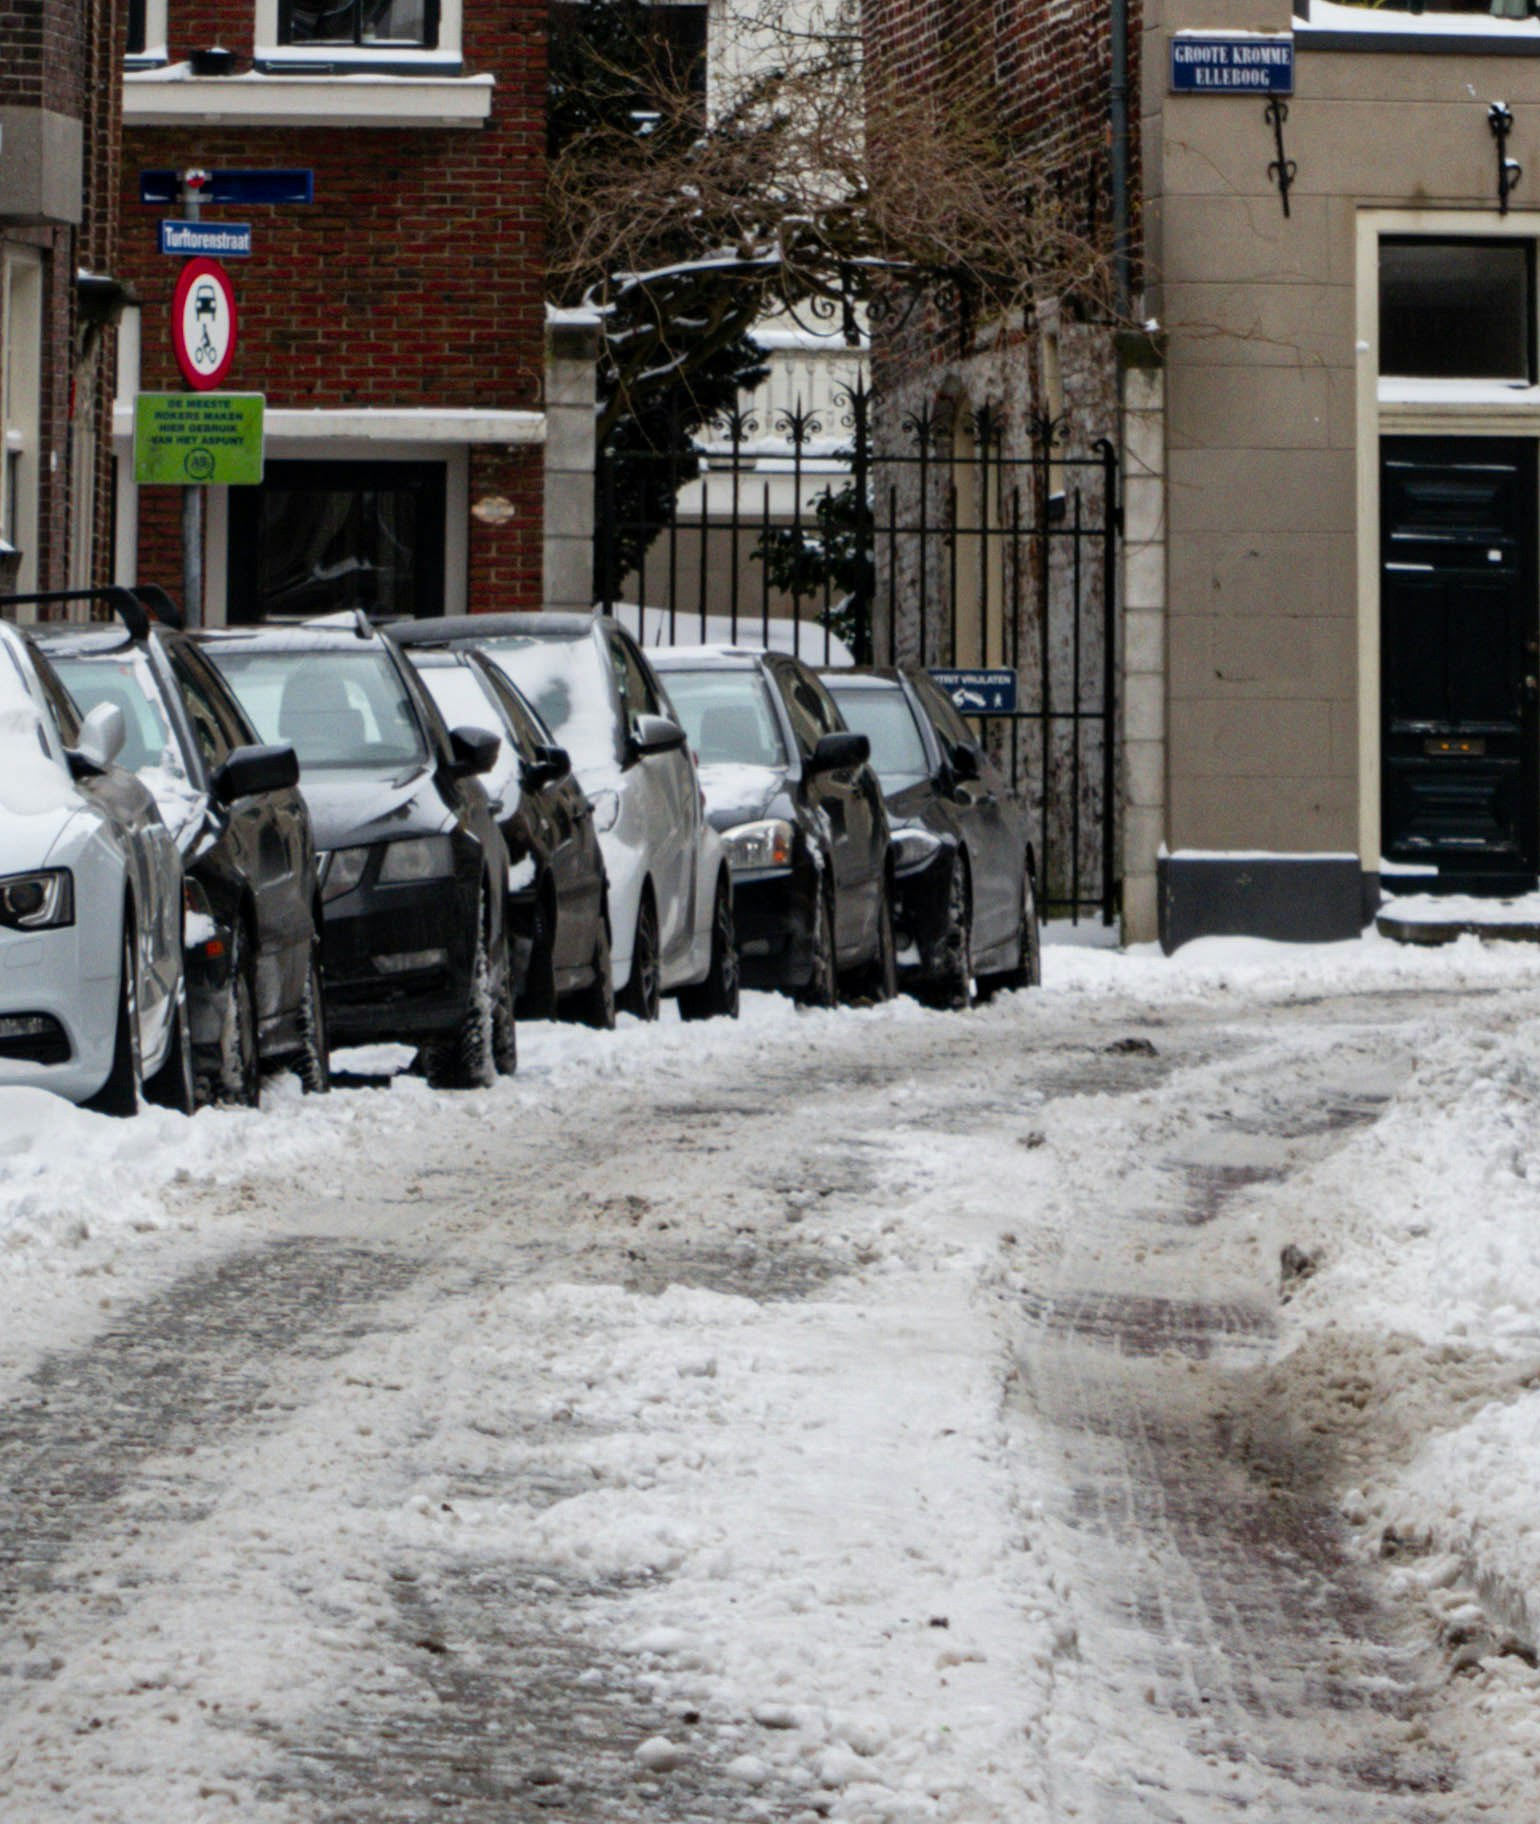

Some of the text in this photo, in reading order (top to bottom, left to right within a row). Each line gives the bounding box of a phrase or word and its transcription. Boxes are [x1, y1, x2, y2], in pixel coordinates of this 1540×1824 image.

[1175, 46, 1290, 65] GROOTE KROMME
[1195, 67, 1270, 86] ELLEBOOG
[165, 226, 249, 250] Turftorenstraat
